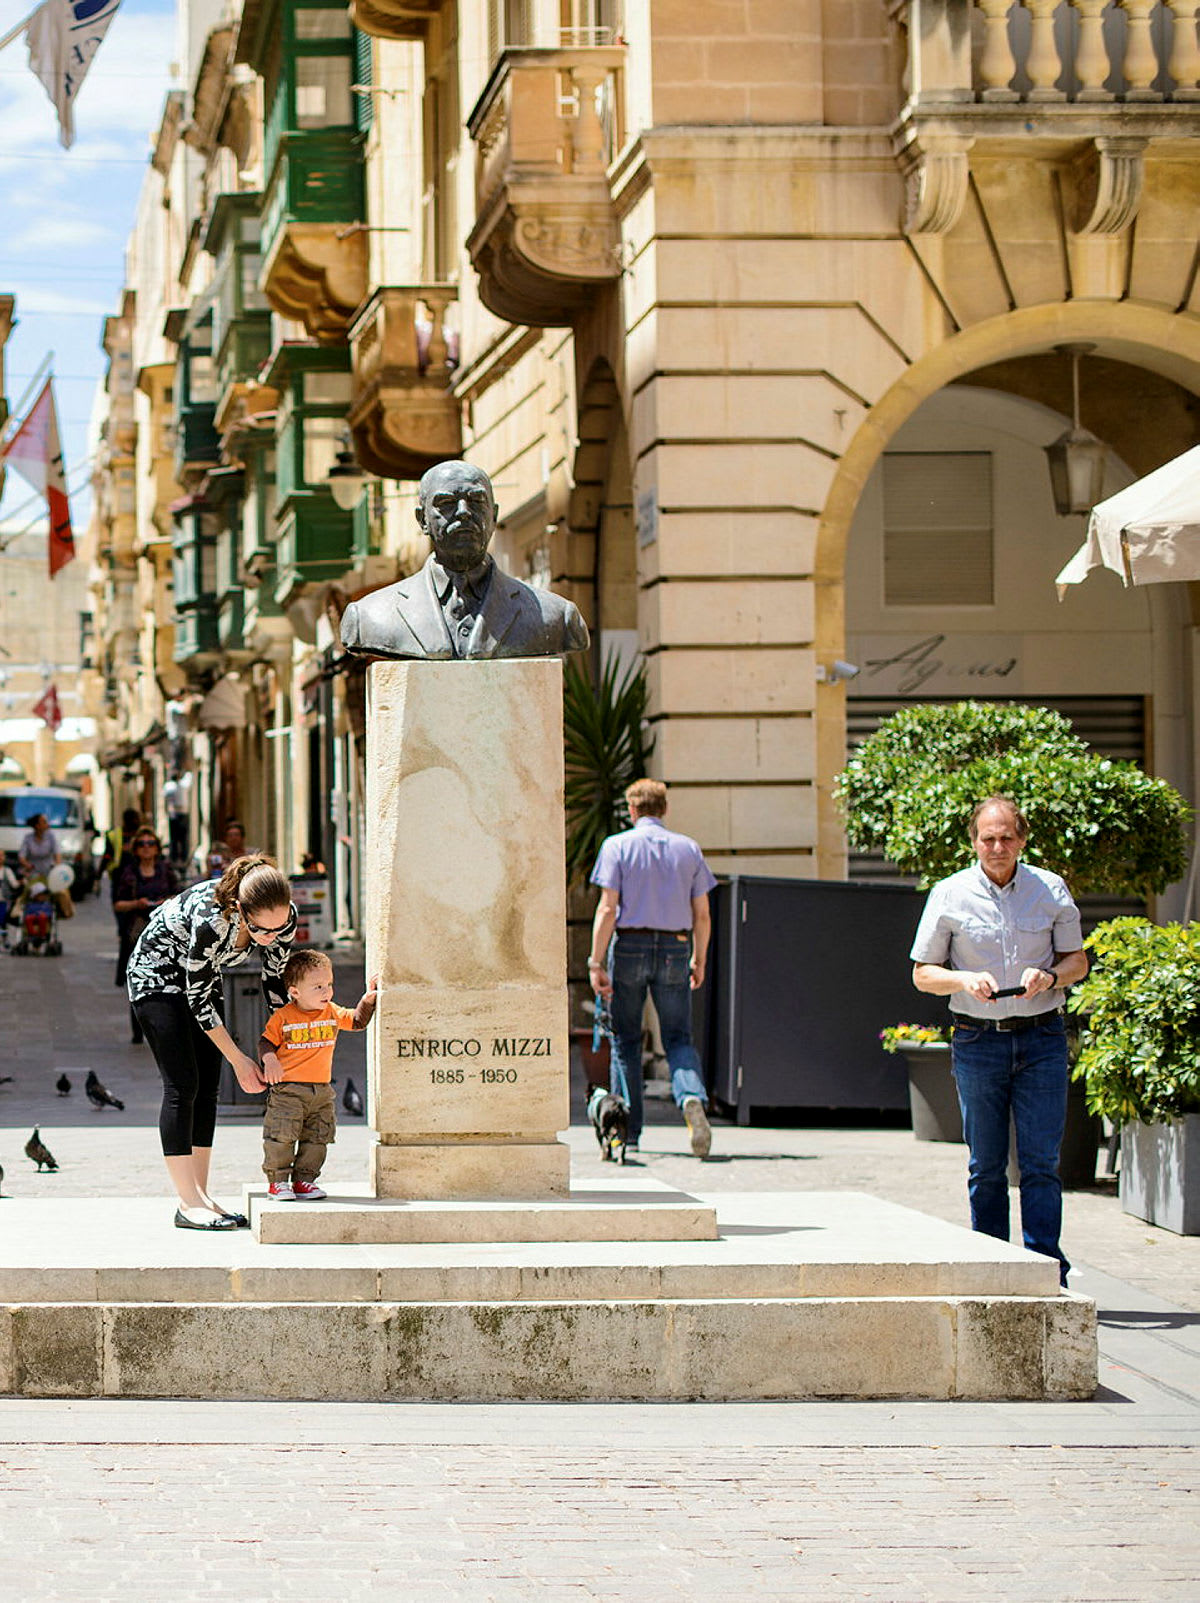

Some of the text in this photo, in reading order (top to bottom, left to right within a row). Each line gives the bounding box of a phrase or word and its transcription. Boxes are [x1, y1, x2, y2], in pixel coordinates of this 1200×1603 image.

[397, 1038, 552, 1058] ENRICO MIZZI
[430, 1069, 464, 1084] 1885
[479, 1069, 518, 1083] 1950
